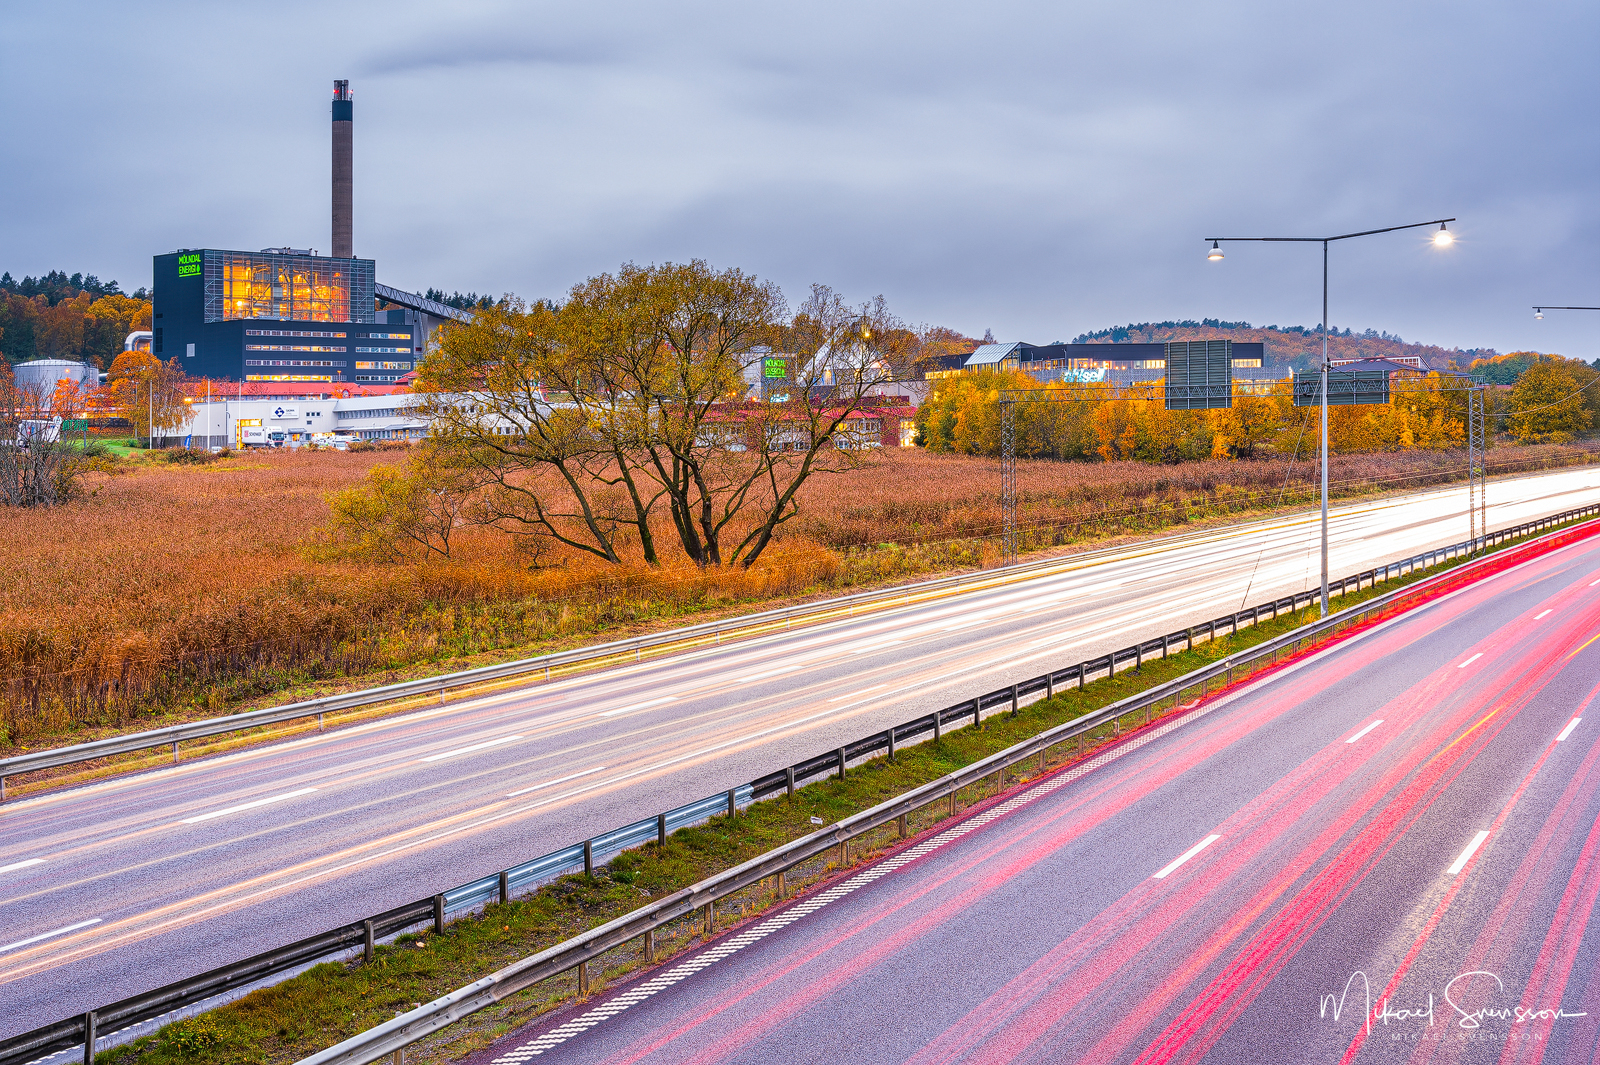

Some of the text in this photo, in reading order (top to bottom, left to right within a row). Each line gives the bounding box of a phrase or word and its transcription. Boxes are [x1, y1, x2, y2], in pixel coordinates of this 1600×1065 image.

[179, 254, 201, 264] MÖLNDAL
[179, 265, 196, 274] ENERGI
[1064, 367, 1105, 383] ahlsell
